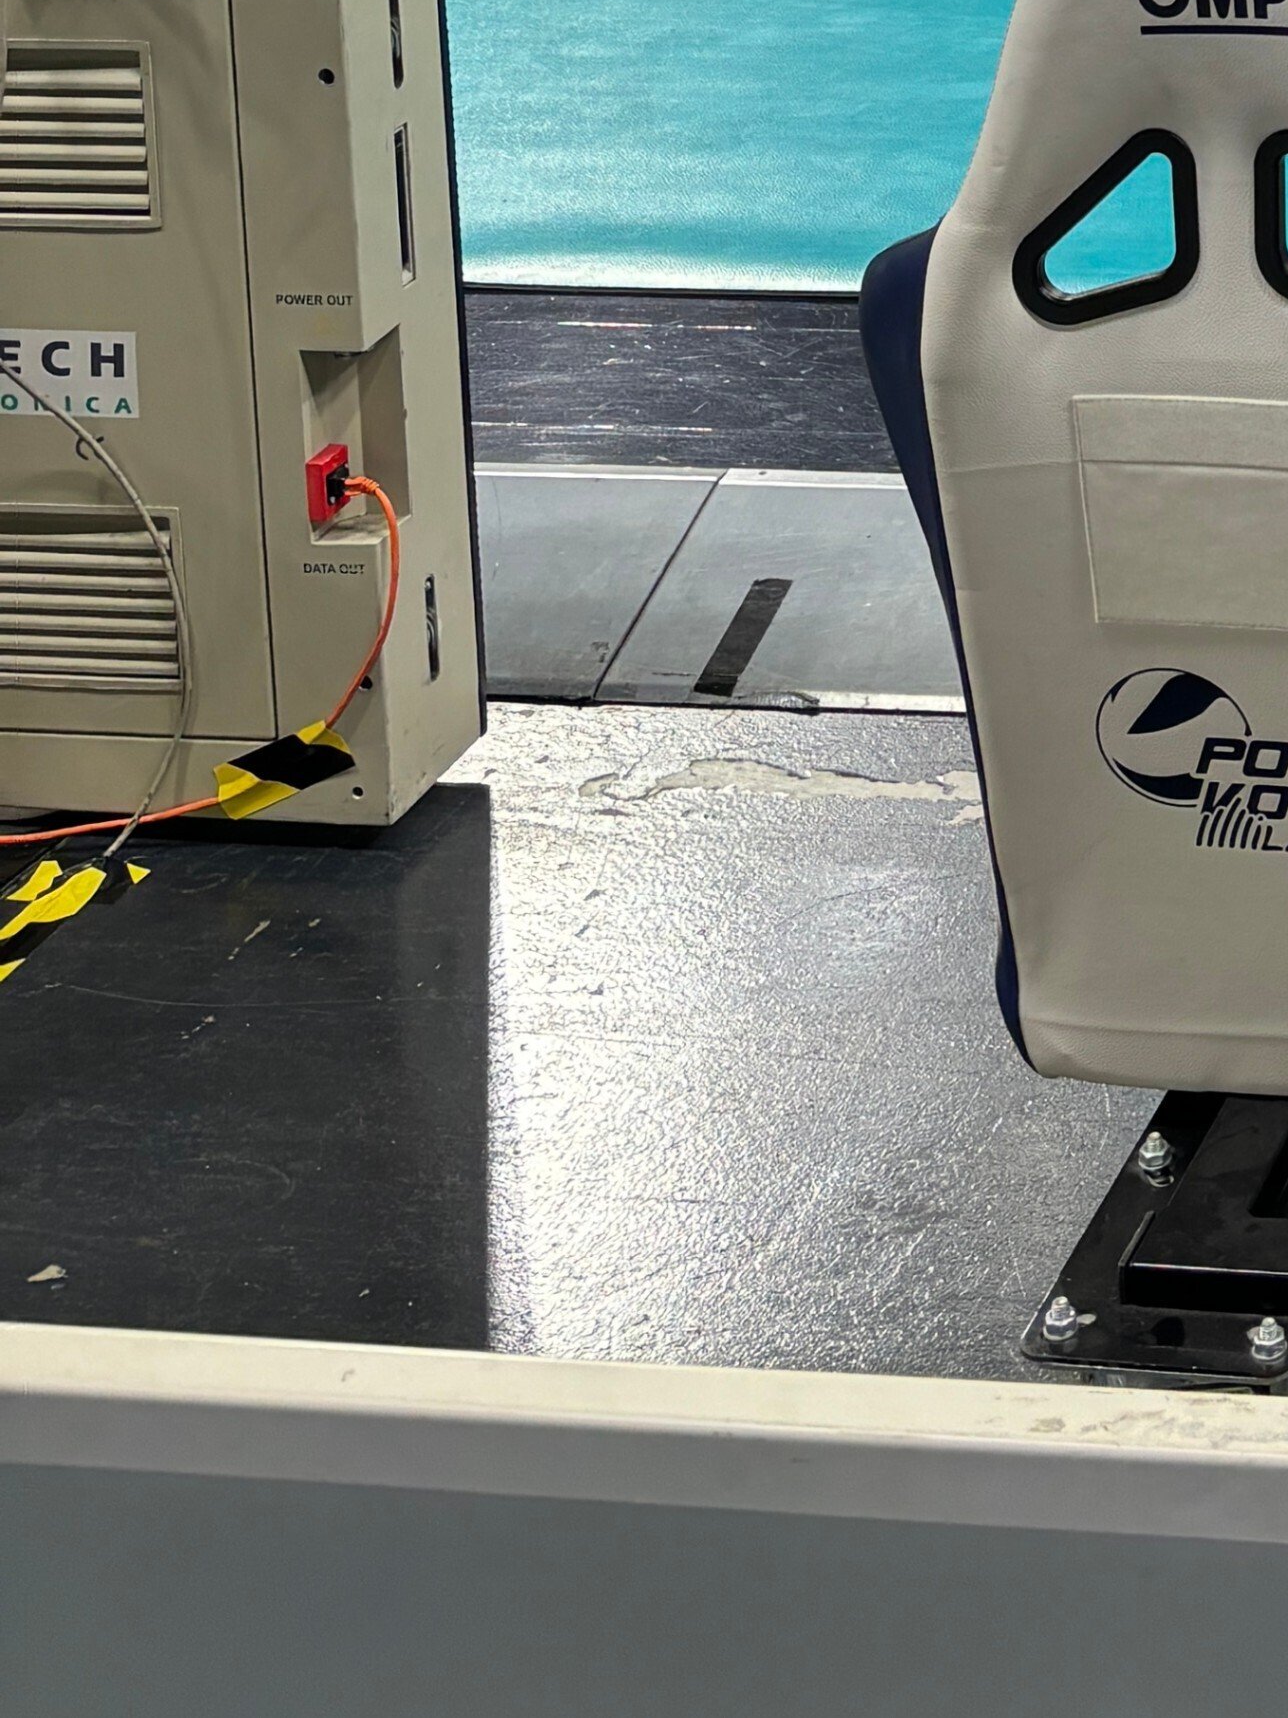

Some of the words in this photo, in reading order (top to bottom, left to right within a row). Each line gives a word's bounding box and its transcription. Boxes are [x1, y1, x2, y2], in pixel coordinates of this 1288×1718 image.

[276, 294, 323, 306] POWER
[327, 295, 353, 307] OUT
[303, 563, 337, 575] DATA
[339, 563, 366, 575] OUT
